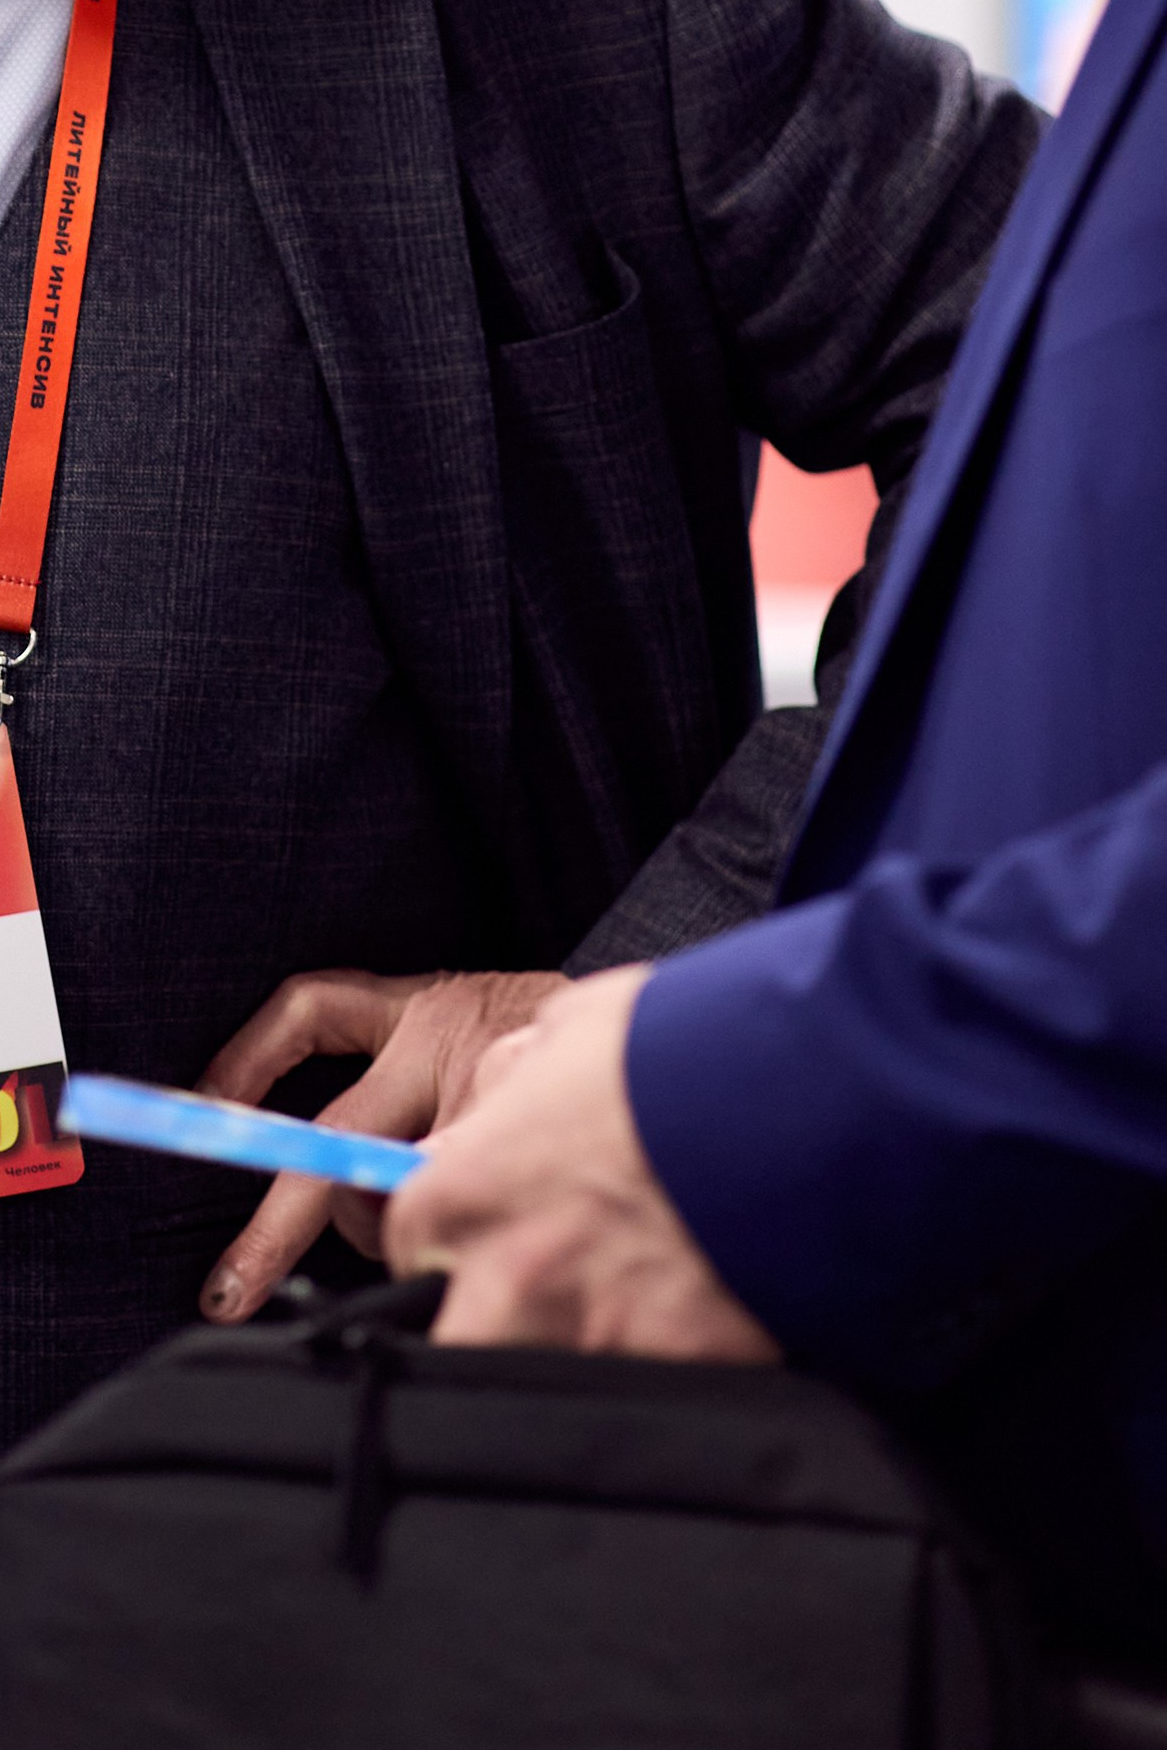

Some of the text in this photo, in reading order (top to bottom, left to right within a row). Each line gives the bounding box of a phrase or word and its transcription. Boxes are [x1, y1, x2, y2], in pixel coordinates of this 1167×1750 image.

[30, 110, 86, 410] ЛИТЕЙНЫЙ ИНТЕНСИВ
[5, 1160, 62, 1178] Человек
